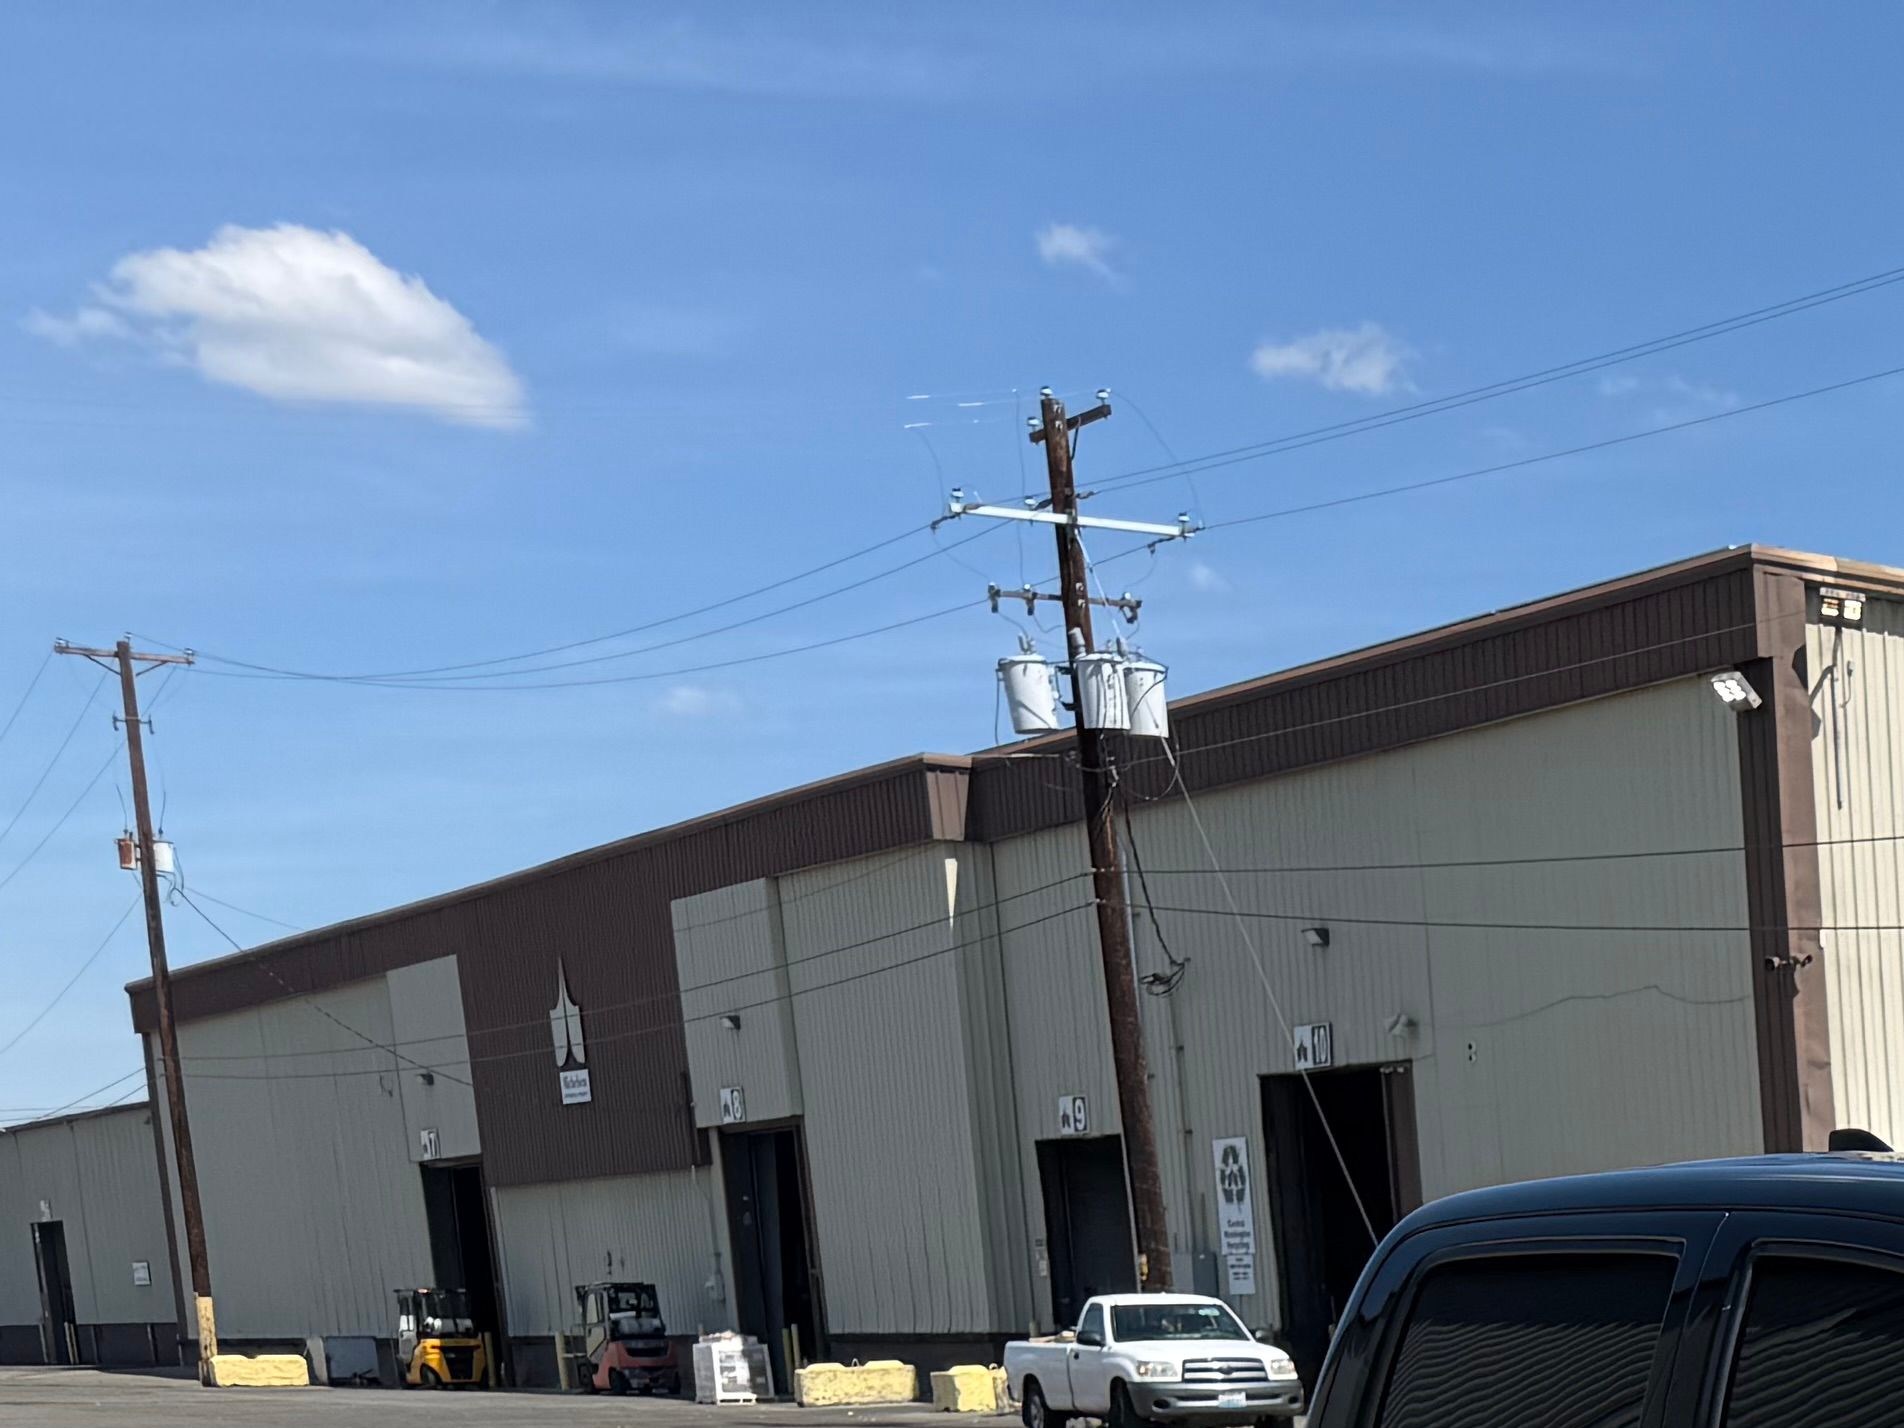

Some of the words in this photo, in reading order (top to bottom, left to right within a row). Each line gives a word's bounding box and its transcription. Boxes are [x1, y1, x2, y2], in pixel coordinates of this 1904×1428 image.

[1313, 1026, 1327, 1065] 10
[732, 1089, 742, 1120] 8
[1074, 1097, 1086, 1131] 9
